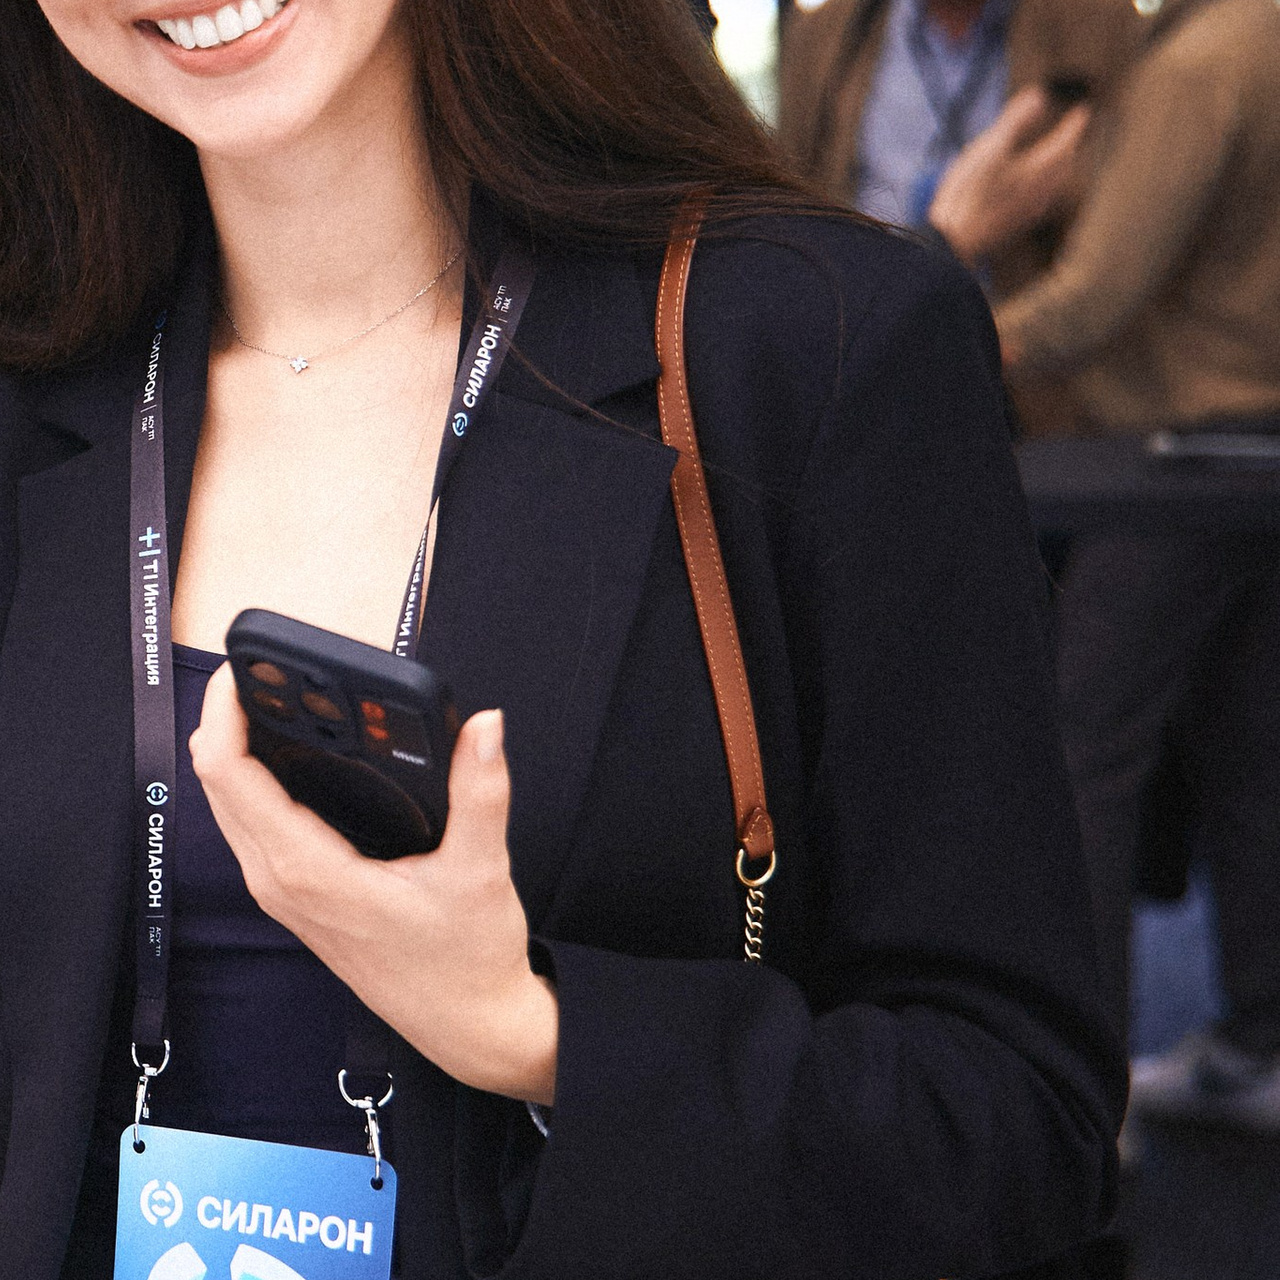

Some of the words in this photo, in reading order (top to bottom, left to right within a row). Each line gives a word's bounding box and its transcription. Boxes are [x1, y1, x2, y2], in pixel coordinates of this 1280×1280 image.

[143, 332, 162, 404] СИЛАРОН
[462, 324, 502, 408] СИЛАРОН
[142, 584, 160, 686] Интеграция
[148, 813, 165, 908] СИЛАРОН
[196, 1195, 374, 1255] СИЛАРОН
